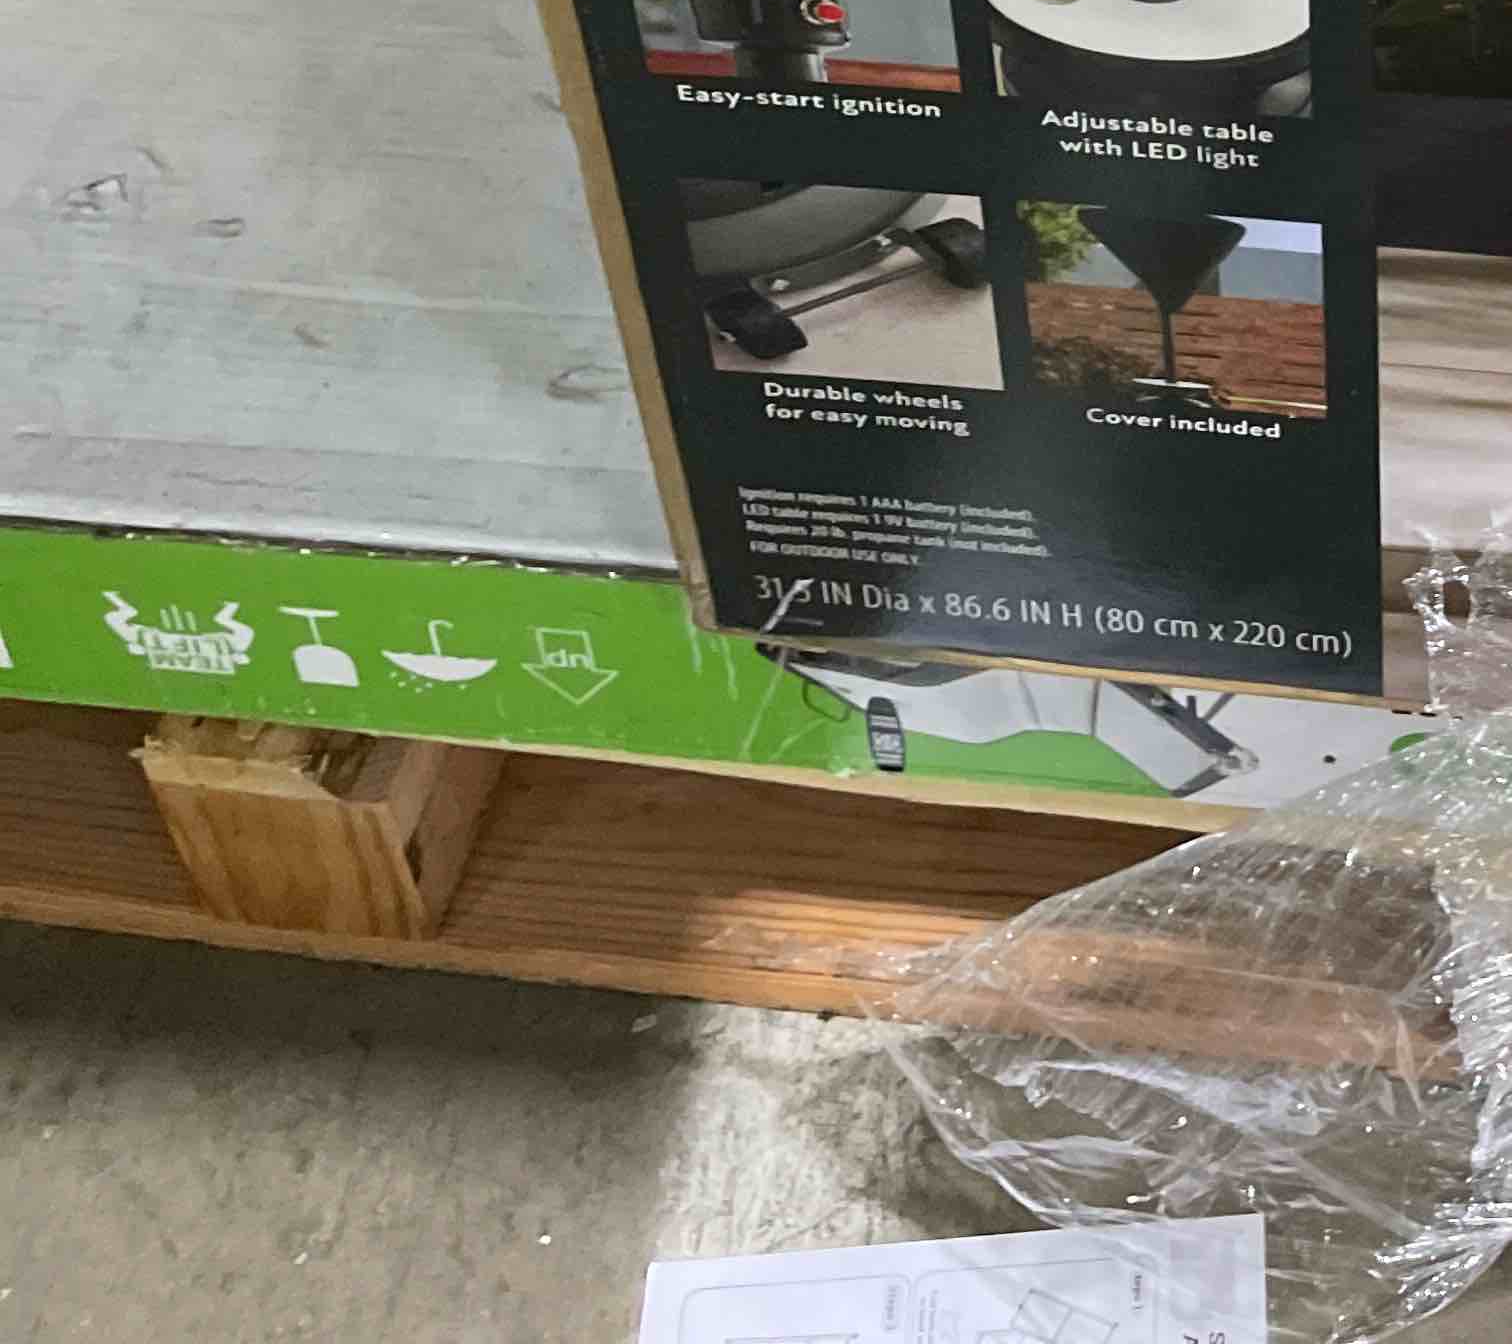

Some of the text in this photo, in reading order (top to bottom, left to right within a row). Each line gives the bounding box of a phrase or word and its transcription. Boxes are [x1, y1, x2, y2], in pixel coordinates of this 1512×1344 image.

[676, 84, 941, 117] Easy-start ignition
[1040, 110, 1274, 143] Adjustable table
[1059, 138, 1259, 170] with LED light
[763, 382, 964, 411] Durable wheels
[765, 403, 970, 437] for easy moving
[1086, 408, 1281, 439] Cover included
[820, 581, 852, 605] IN
[862, 584, 910, 611] Dia
[918, 594, 936, 614] x
[944, 592, 1011, 621] 86.6
[1020, 599, 1050, 625] IN
[1061, 602, 1083, 628] H
[1094, 605, 1144, 635] (80
[1153, 617, 1199, 640] cm
[1208, 622, 1224, 642] x
[1232, 619, 1285, 648] 220
[1295, 630, 1352, 659] cm)
